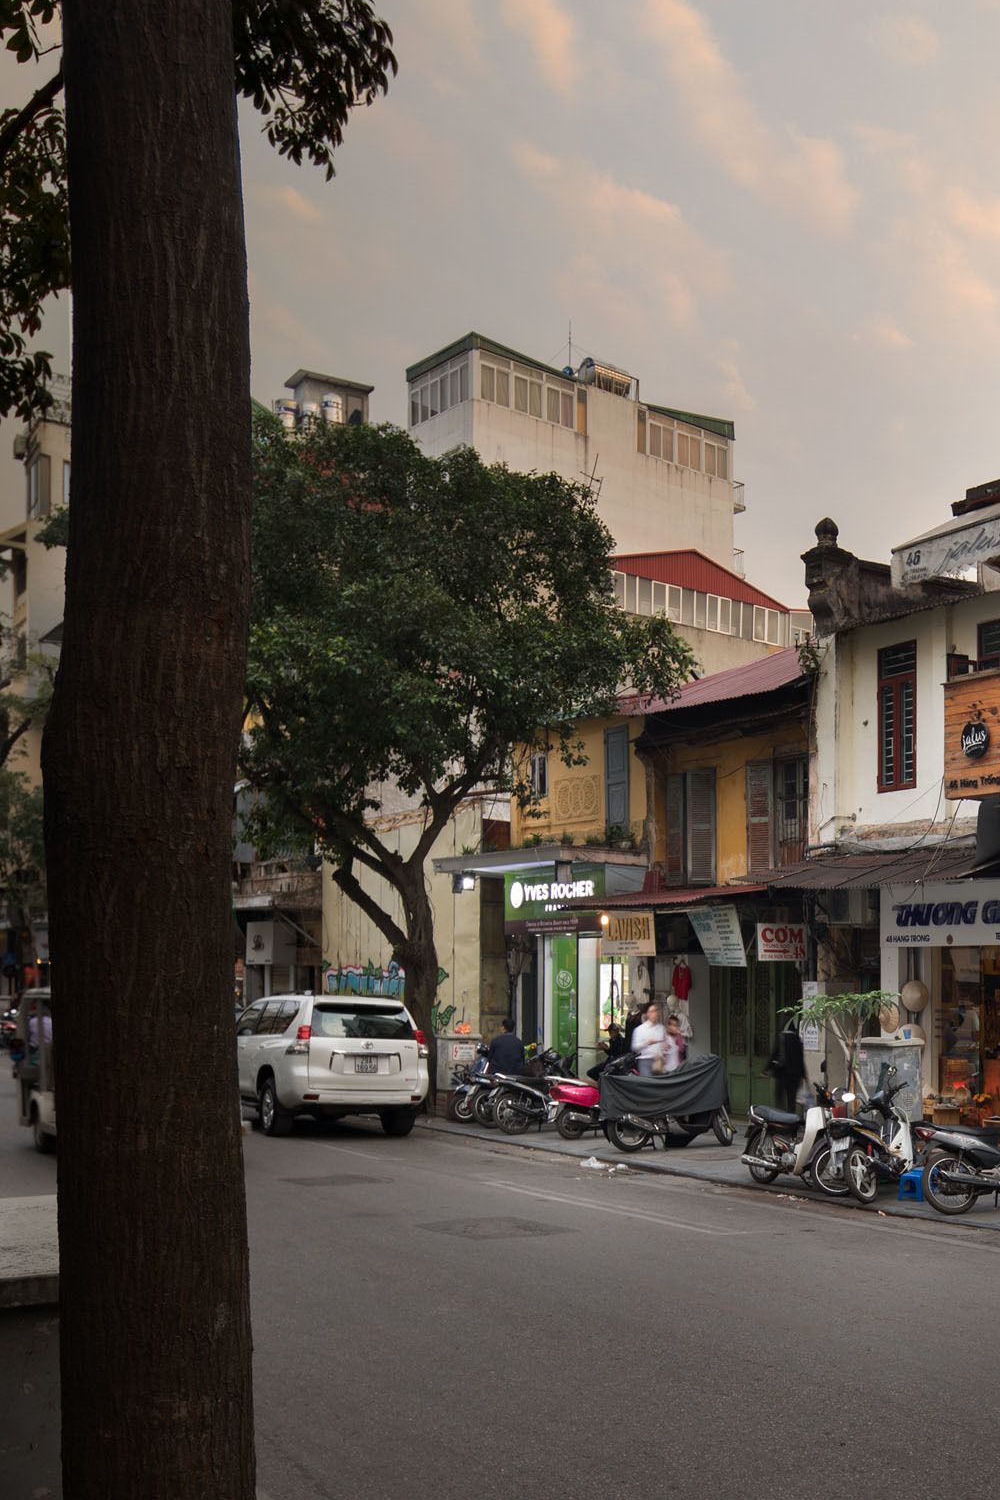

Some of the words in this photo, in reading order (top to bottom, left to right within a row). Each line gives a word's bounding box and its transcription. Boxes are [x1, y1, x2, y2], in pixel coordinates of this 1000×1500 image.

[905, 550, 921, 567] 46
[962, 726, 986, 755] jalus
[523, 883, 550, 901] YVES
[550, 880, 594, 900] ROCHER
[607, 916, 650, 941] LAVISH
